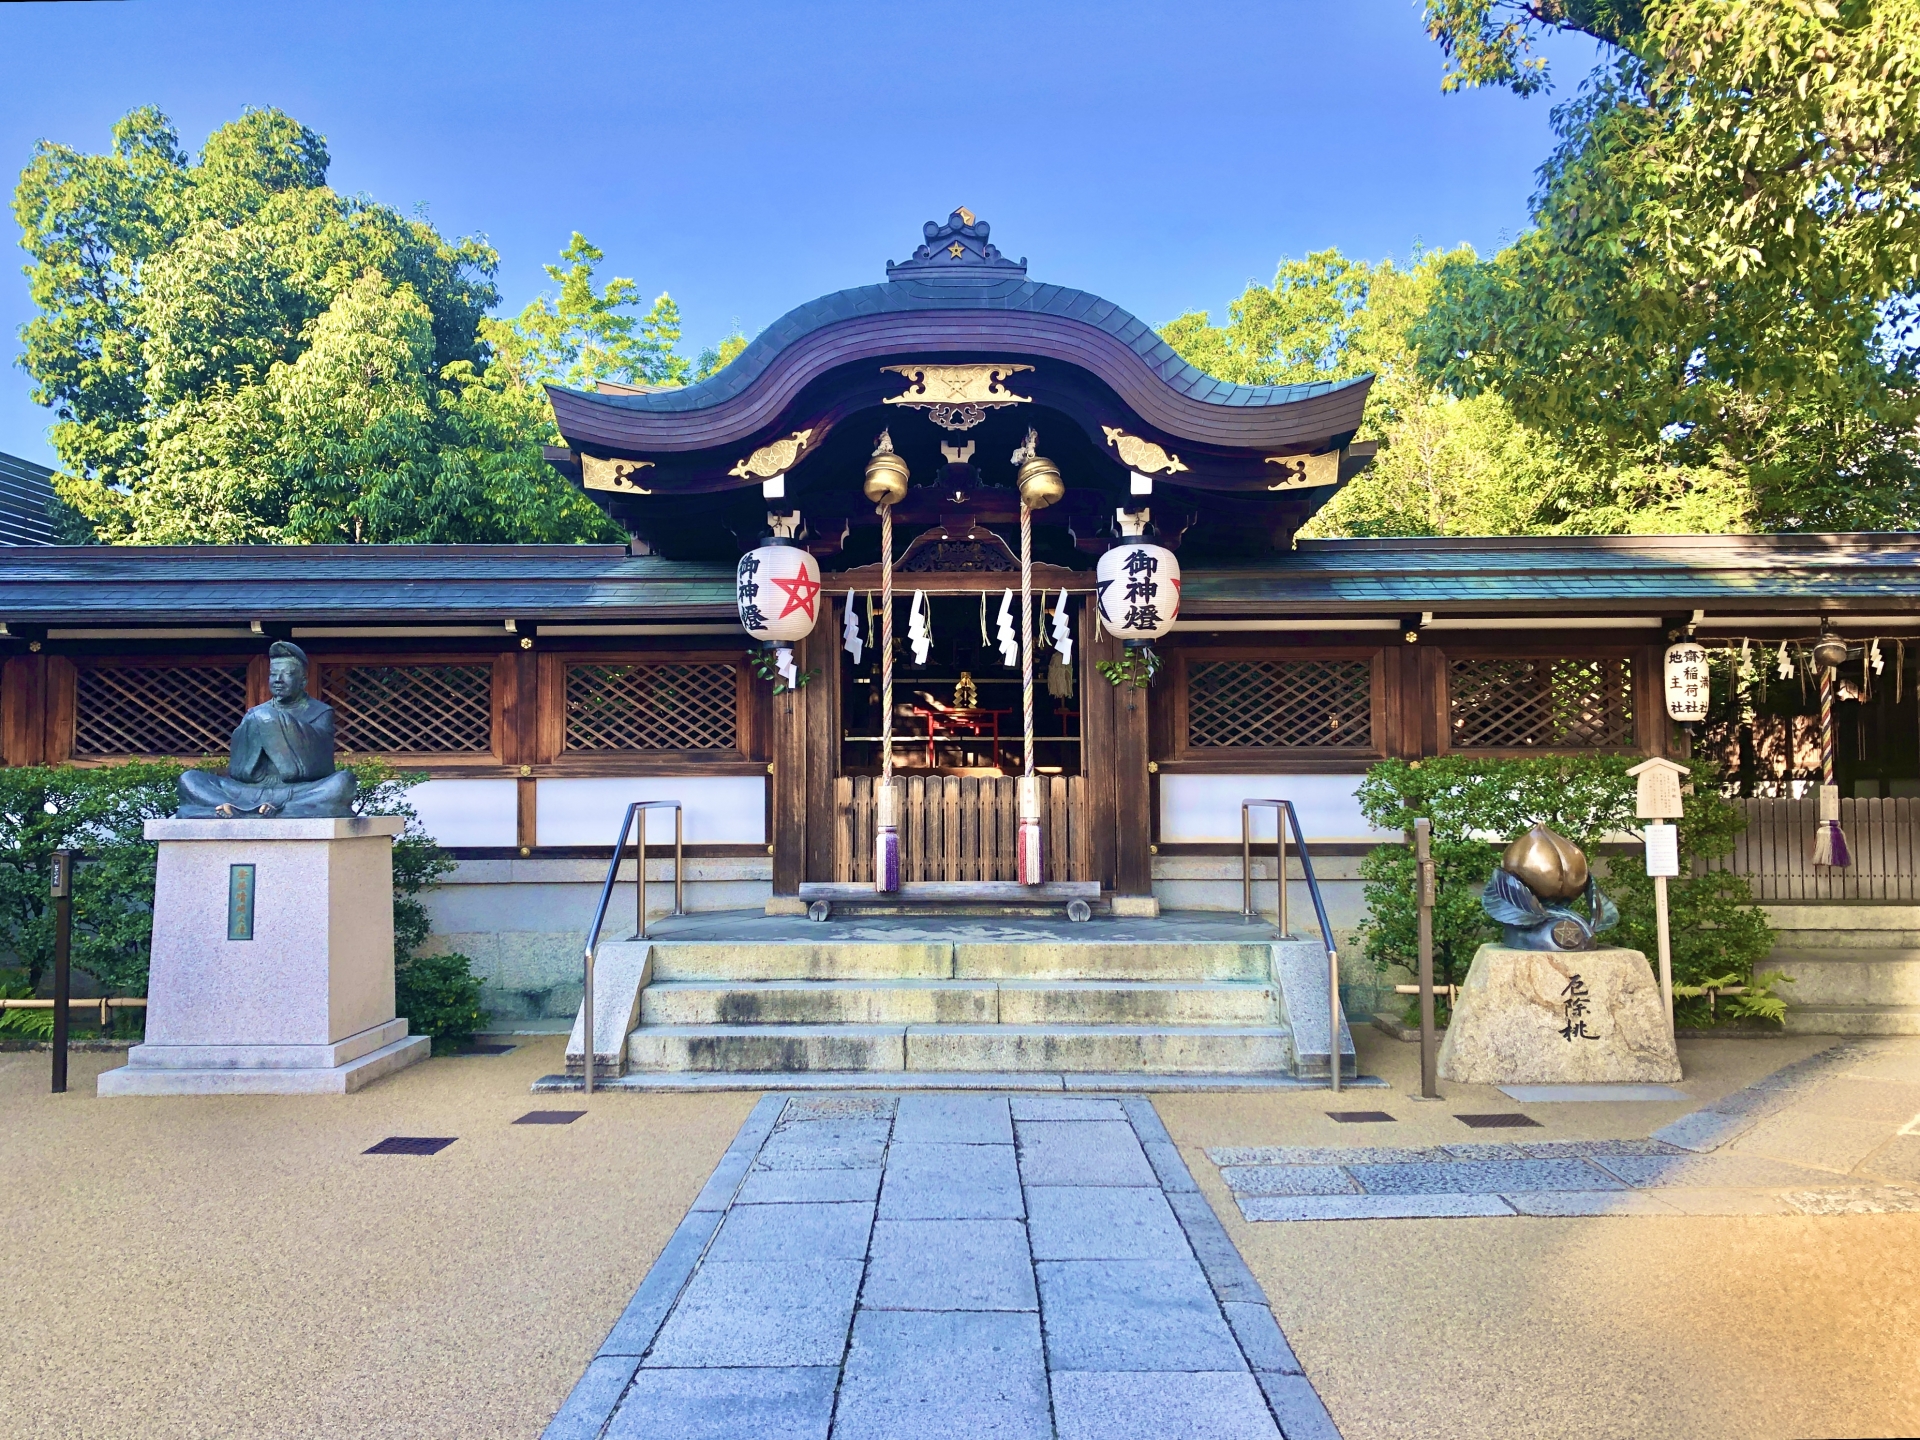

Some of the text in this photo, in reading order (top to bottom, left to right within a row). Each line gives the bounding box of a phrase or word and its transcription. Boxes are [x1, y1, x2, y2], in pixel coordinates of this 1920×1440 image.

[738, 552, 769, 631] 御神燈
[1121, 548, 1164, 631] 御神燈
[1668, 650, 1684, 714] 地主社
[1558, 973, 1601, 1042] 厄除桃
